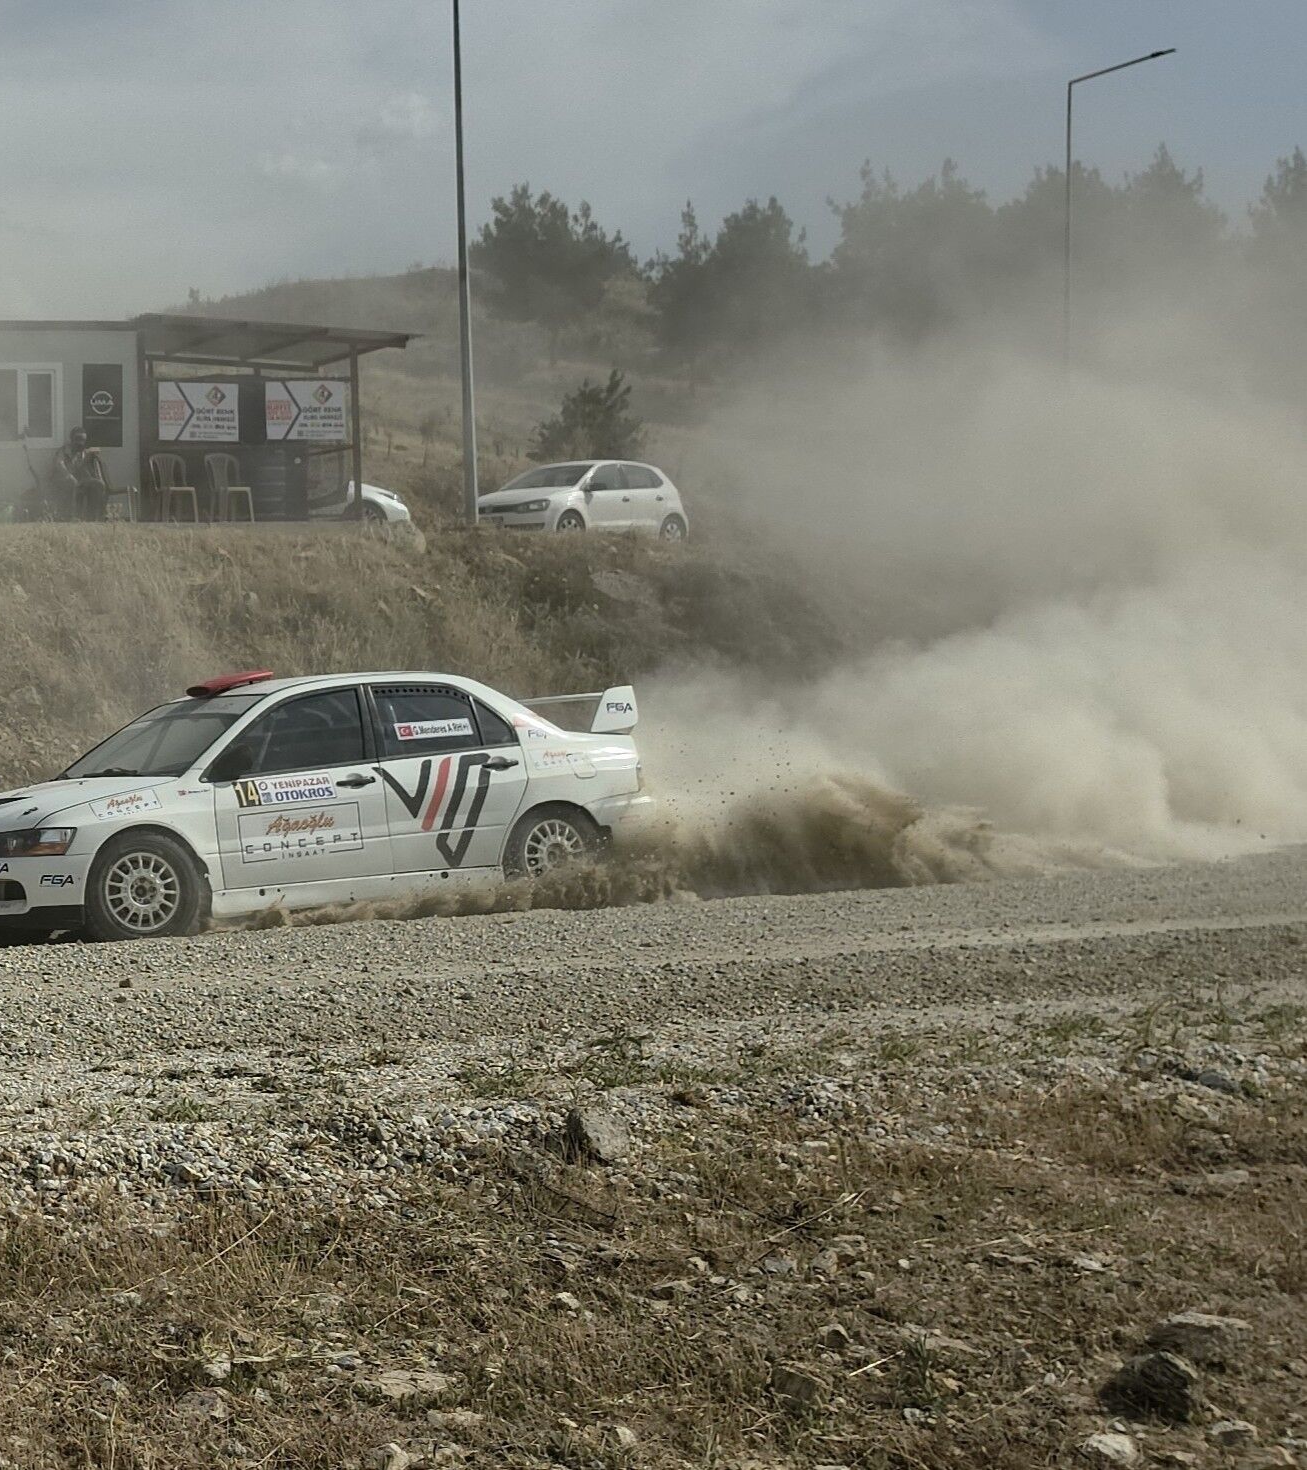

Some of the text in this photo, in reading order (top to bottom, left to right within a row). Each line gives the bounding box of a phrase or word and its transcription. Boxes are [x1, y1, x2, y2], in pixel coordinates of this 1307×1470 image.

[606, 702, 633, 714] FGA
[234, 780, 261, 807] 14
[274, 786, 334, 802] OTOKROS
[265, 810, 335, 838] Ağaoğlu
[245, 832, 358, 855] CONCEPT
[39, 874, 75, 888] FGA
